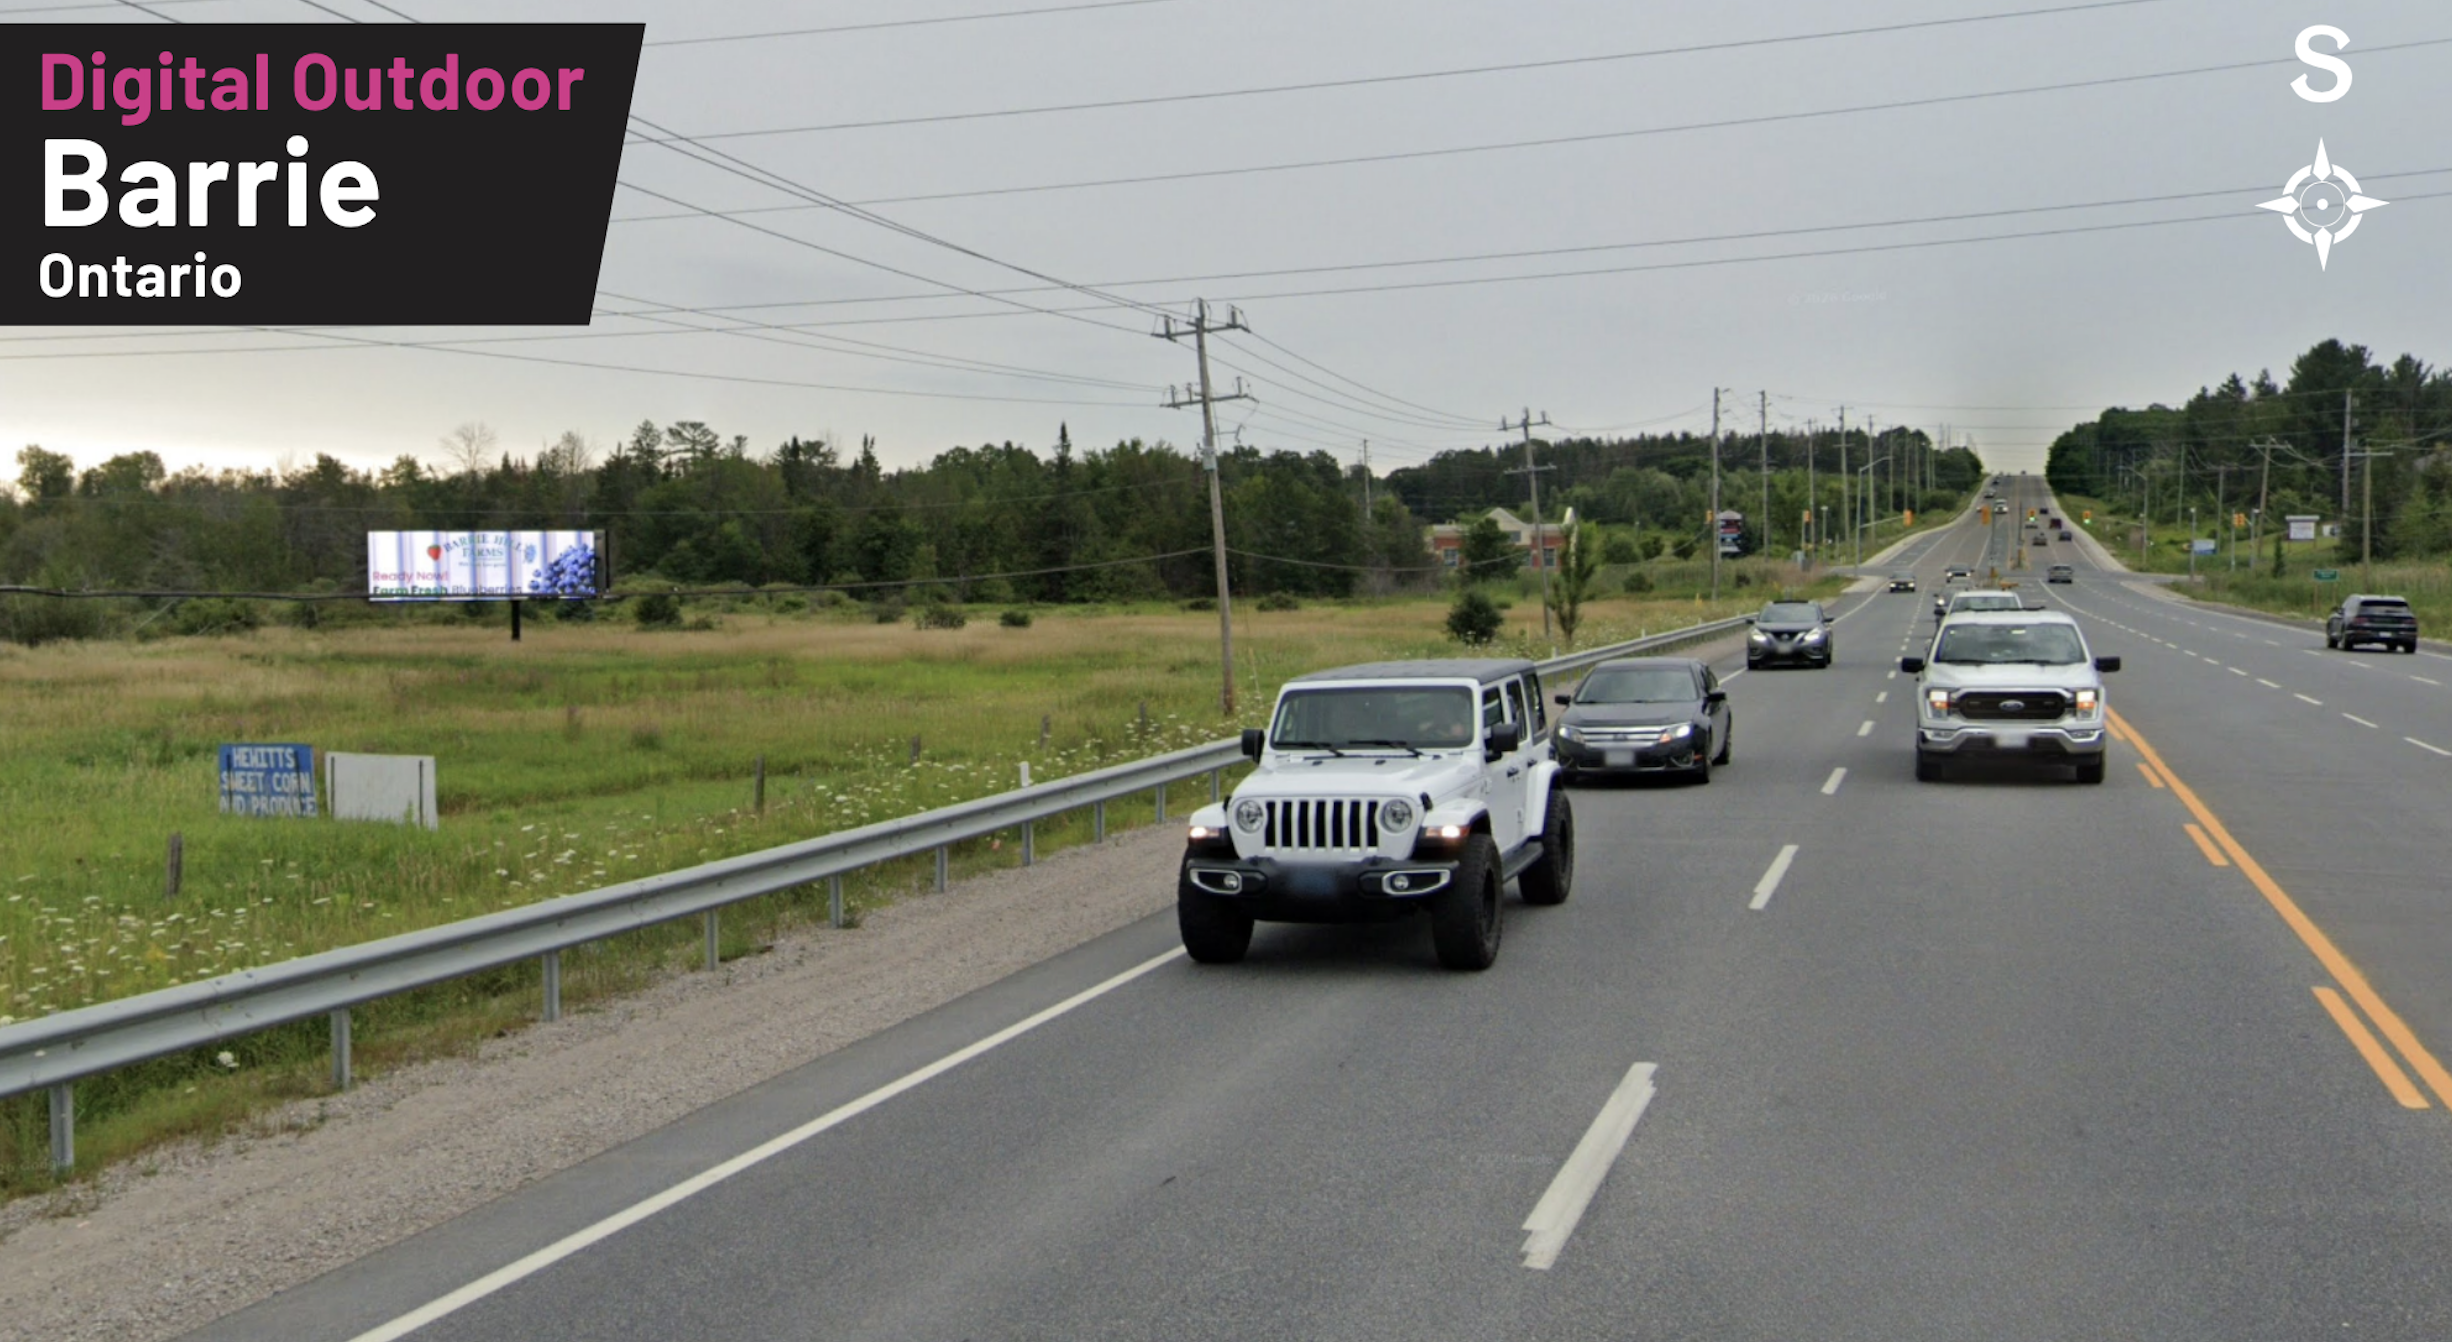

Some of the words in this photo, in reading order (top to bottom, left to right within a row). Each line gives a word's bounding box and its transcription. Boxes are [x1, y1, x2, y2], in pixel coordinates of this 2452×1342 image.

[462, 548, 504, 558] FARMS
[373, 572, 413, 583] Ready
[417, 571, 449, 582] Now!
[373, 586, 409, 595] Farm
[411, 586, 448, 595] Fresh
[233, 747, 295, 769] HEWITTS
